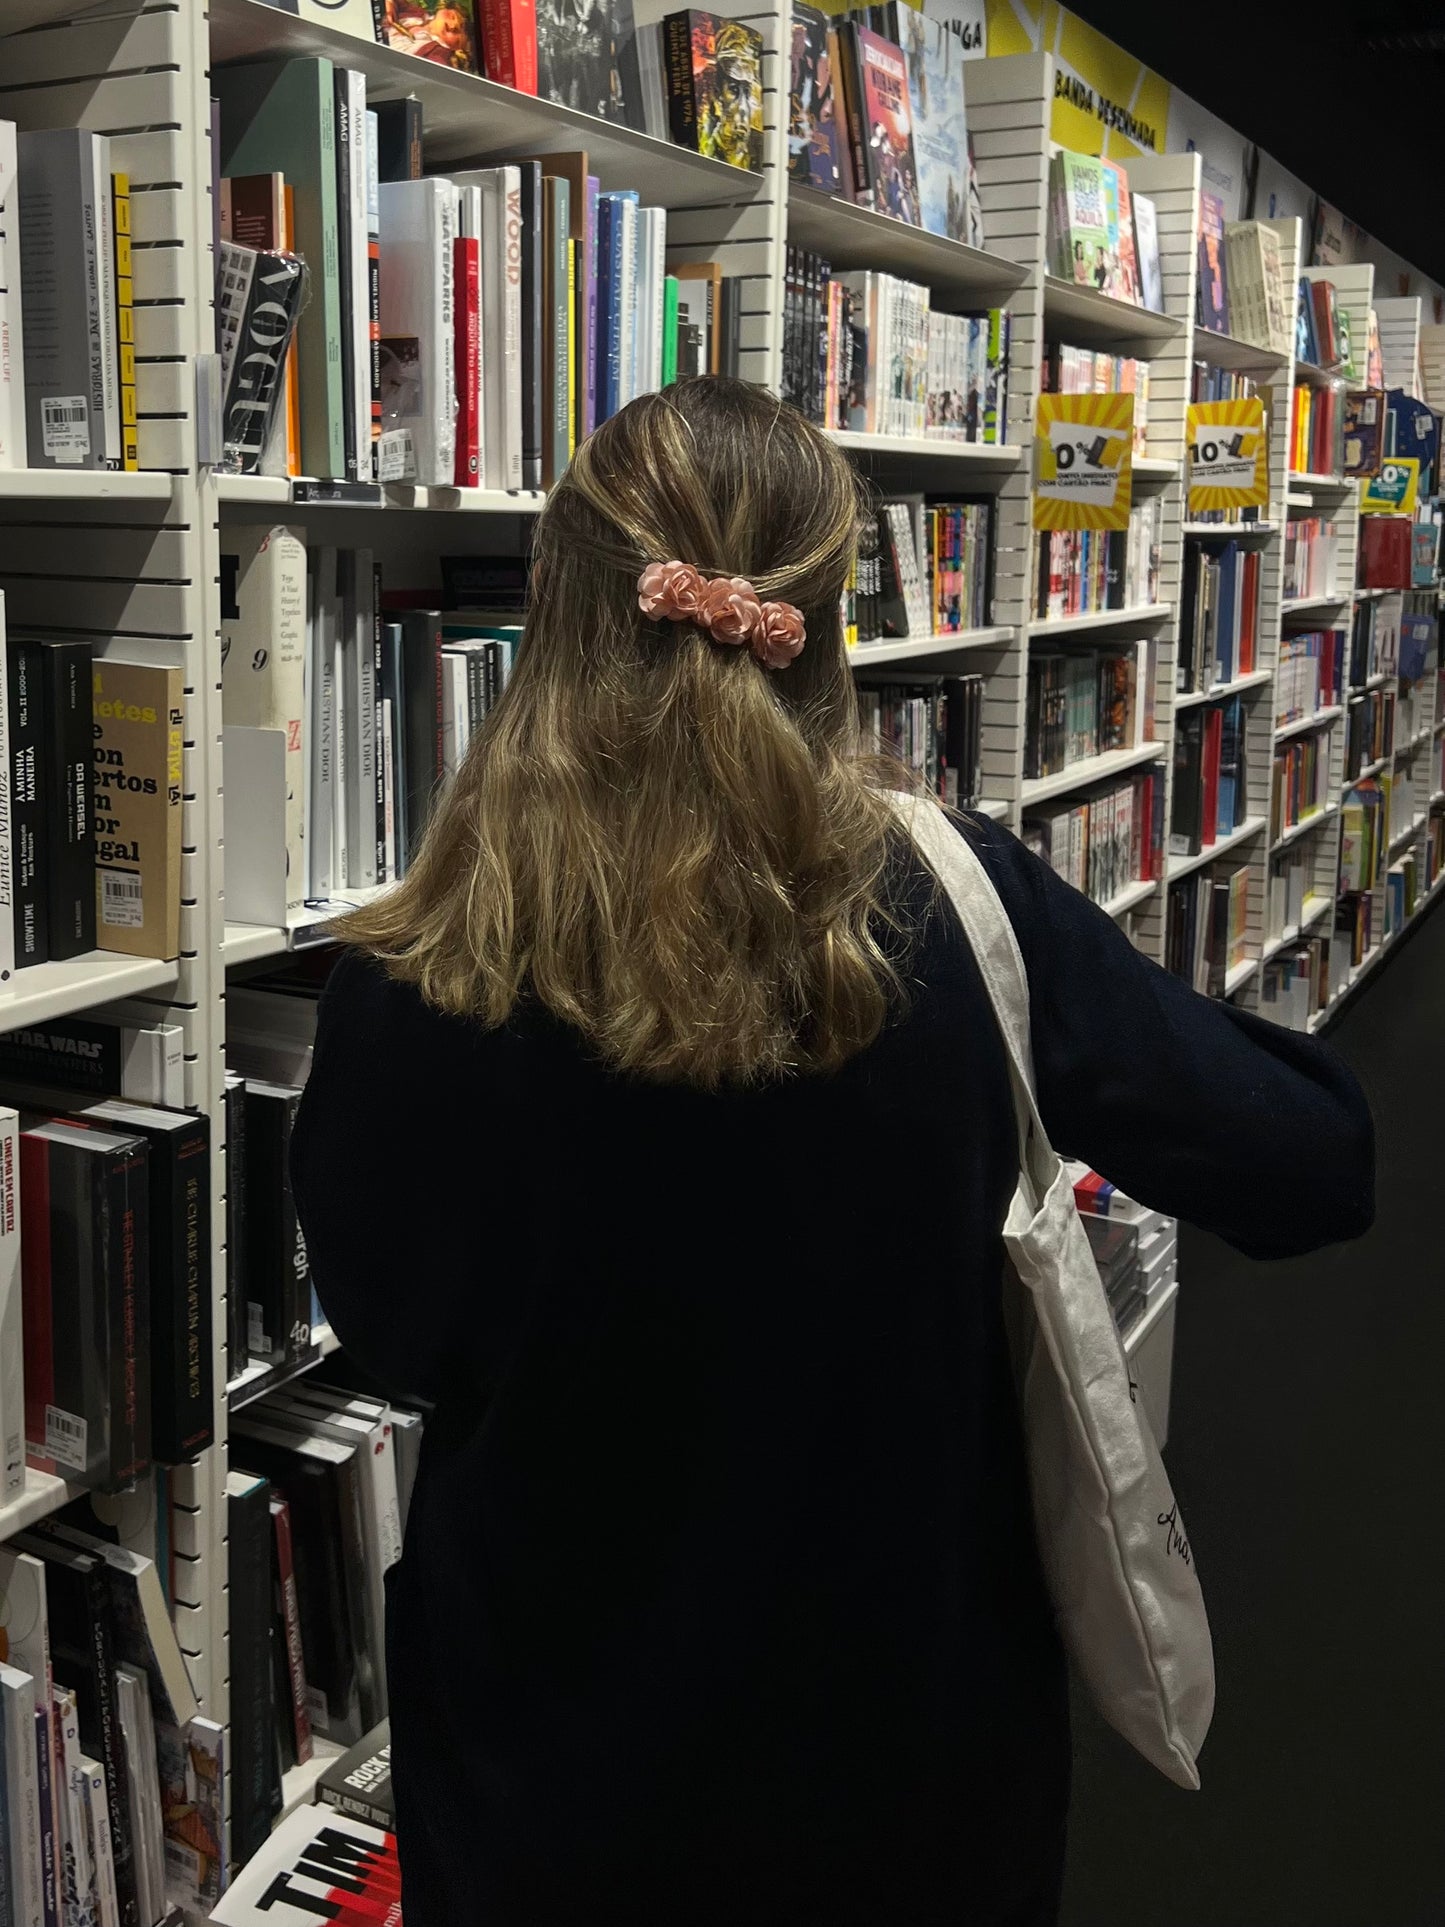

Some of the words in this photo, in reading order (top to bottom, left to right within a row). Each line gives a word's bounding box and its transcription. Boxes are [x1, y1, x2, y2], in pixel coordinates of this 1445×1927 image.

[340, 103, 349, 142] AMAG
[354, 107, 363, 147] AMAG
[1055, 68, 1093, 114] BANDA
[1097, 94, 1155, 150] DESENHADA
[84, 204, 93, 240] SANTOS
[507, 188, 520, 285] WOOD
[613, 219, 623, 306] COASTAL
[2, 331, 10, 358] REBEL
[89, 314, 100, 338] JAZZ
[611, 311, 621, 380] CHARM
[3, 361, 11, 383] LIFE
[1055, 441, 1090, 469] 0%
[20, 708, 28, 728] VOL.
[170, 708, 183, 725] EU
[321, 662, 332, 744] CHRISTIAN
[362, 661, 372, 740] CHRISTIAN
[15, 750, 25, 791] MINHA
[26, 746, 35, 801] MANEIRA
[76, 763, 84, 781] DA
[321, 747, 331, 783] DIOR
[363, 743, 372, 777] DIOR
[94, 769, 157, 795] ertos
[76, 784, 86, 841] WEASEL
[0, 846, 11, 909] Eunice
[24, 903, 35, 953] SHOWTIME
[51, 1035, 104, 1058] WARS
[187, 1203, 198, 1264] CHARLIE
[123, 1234, 134, 1291] STANLEY
[187, 1266, 199, 1330] CHAPLIN
[343, 1757, 389, 1789] ROCK
